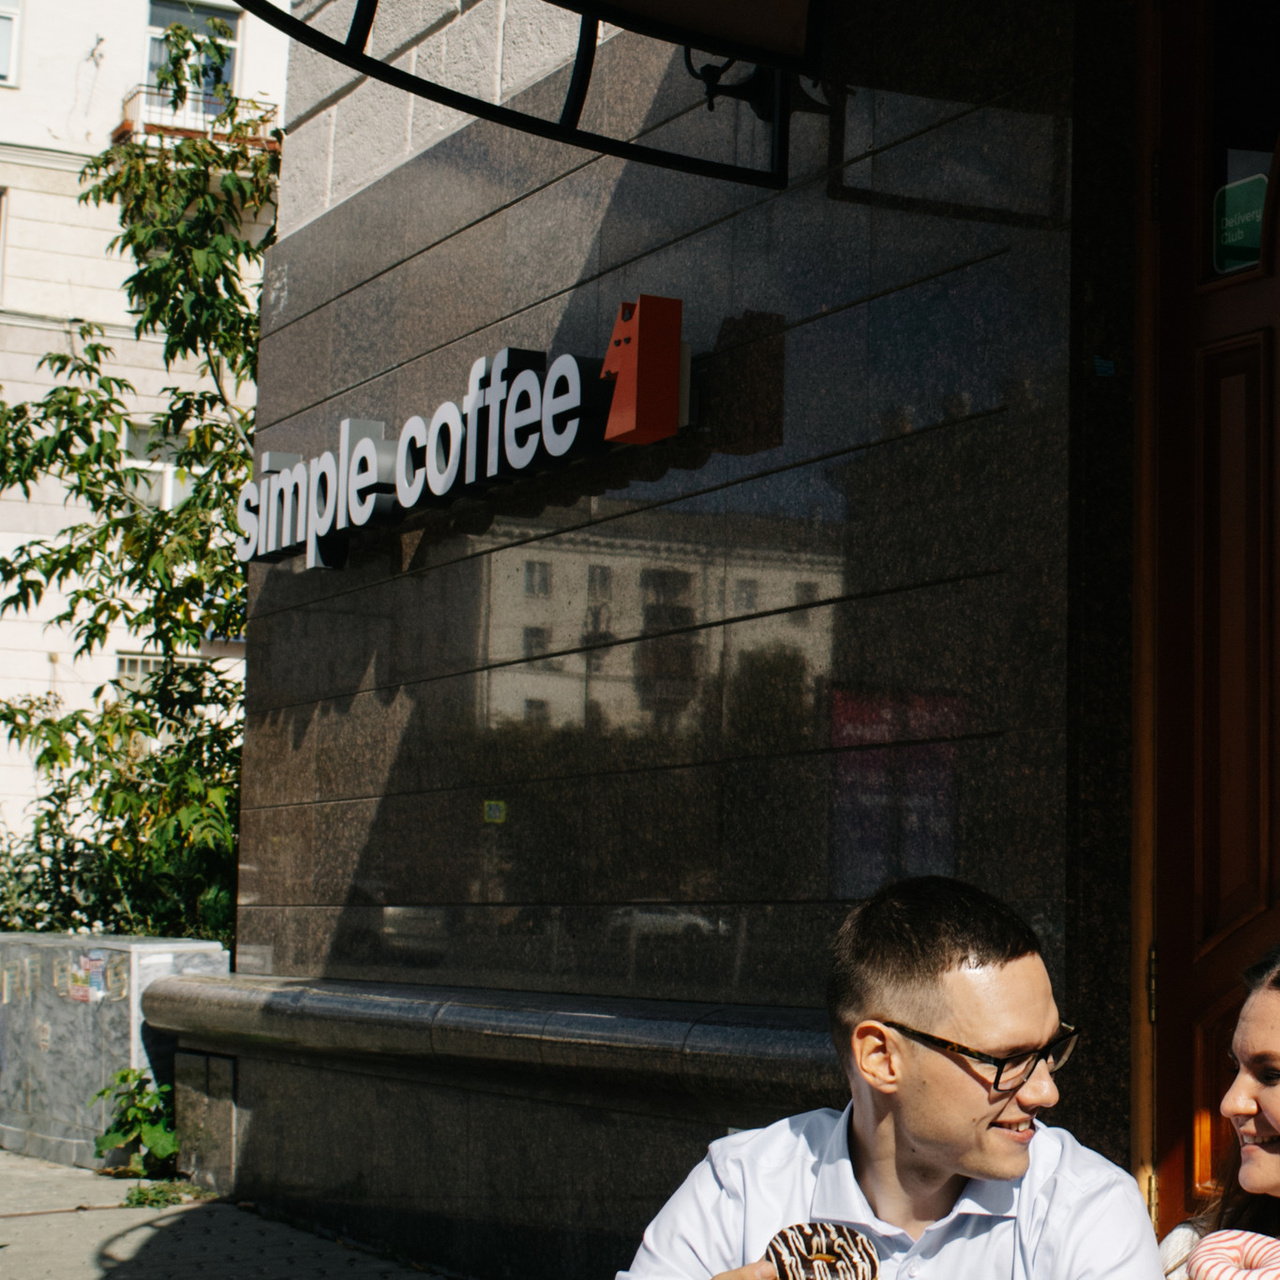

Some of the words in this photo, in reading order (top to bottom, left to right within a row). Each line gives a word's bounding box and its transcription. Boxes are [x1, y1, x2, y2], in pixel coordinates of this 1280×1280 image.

[1221, 208, 1262, 230] Delivery
[1221, 229, 1244, 245] Club
[236, 418, 378, 568] simple
[396, 347, 581, 508] coffee
